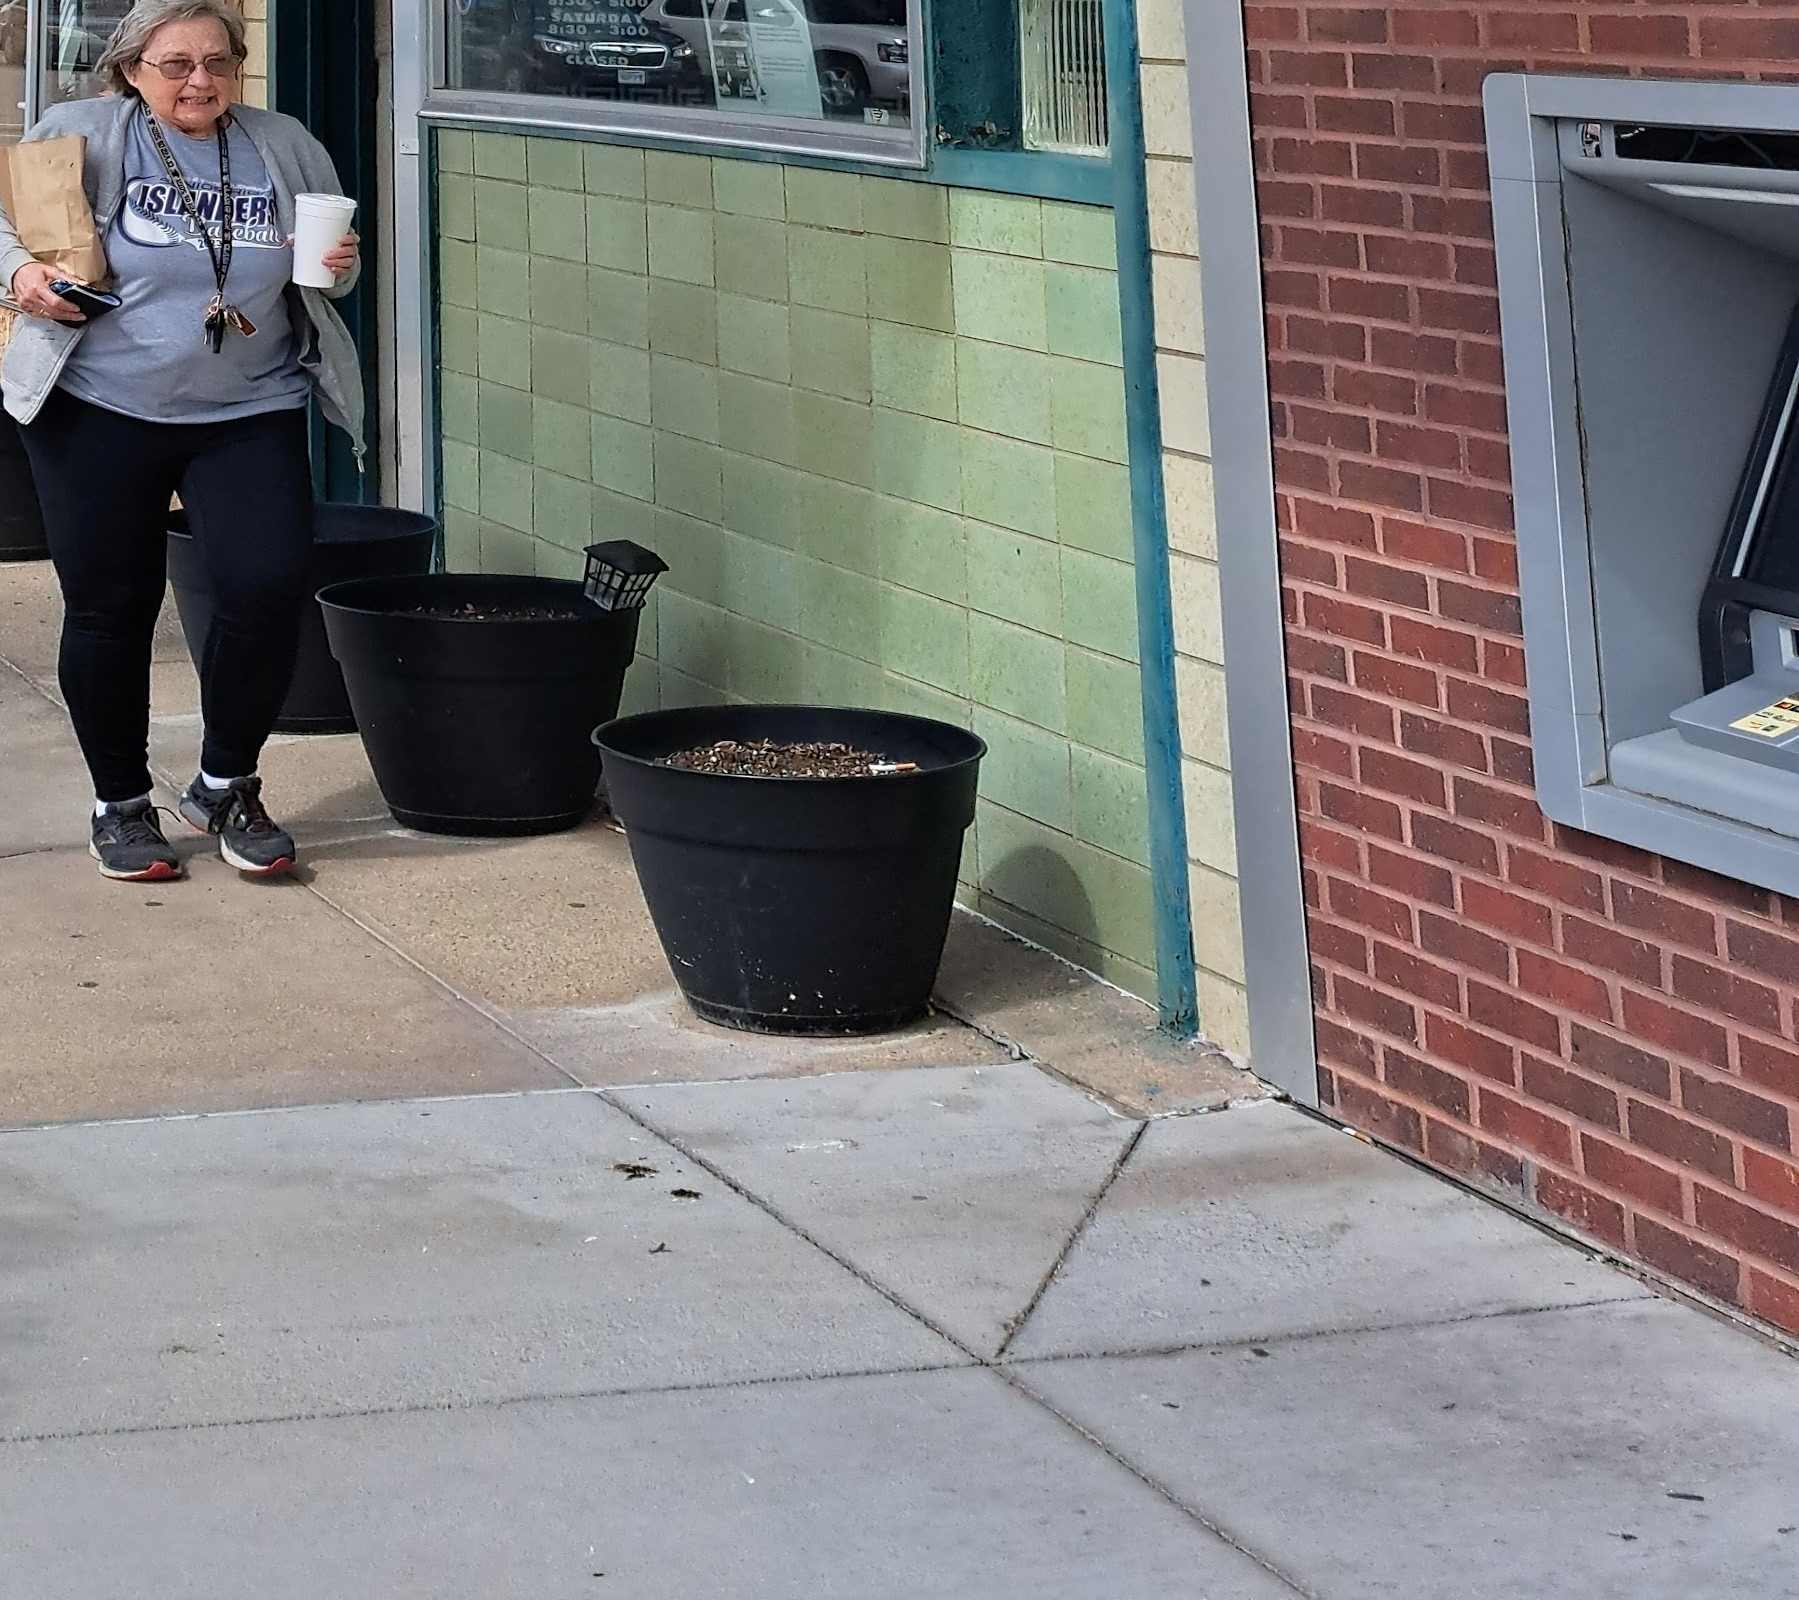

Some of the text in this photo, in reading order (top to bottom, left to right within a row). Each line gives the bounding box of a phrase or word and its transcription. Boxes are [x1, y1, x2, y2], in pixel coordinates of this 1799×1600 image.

[551, 13, 644, 24] SATURDAY
[548, 24, 587, 35] 8:30
[610, 25, 649, 37] 3:00
[566, 55, 629, 66] CLOSED
